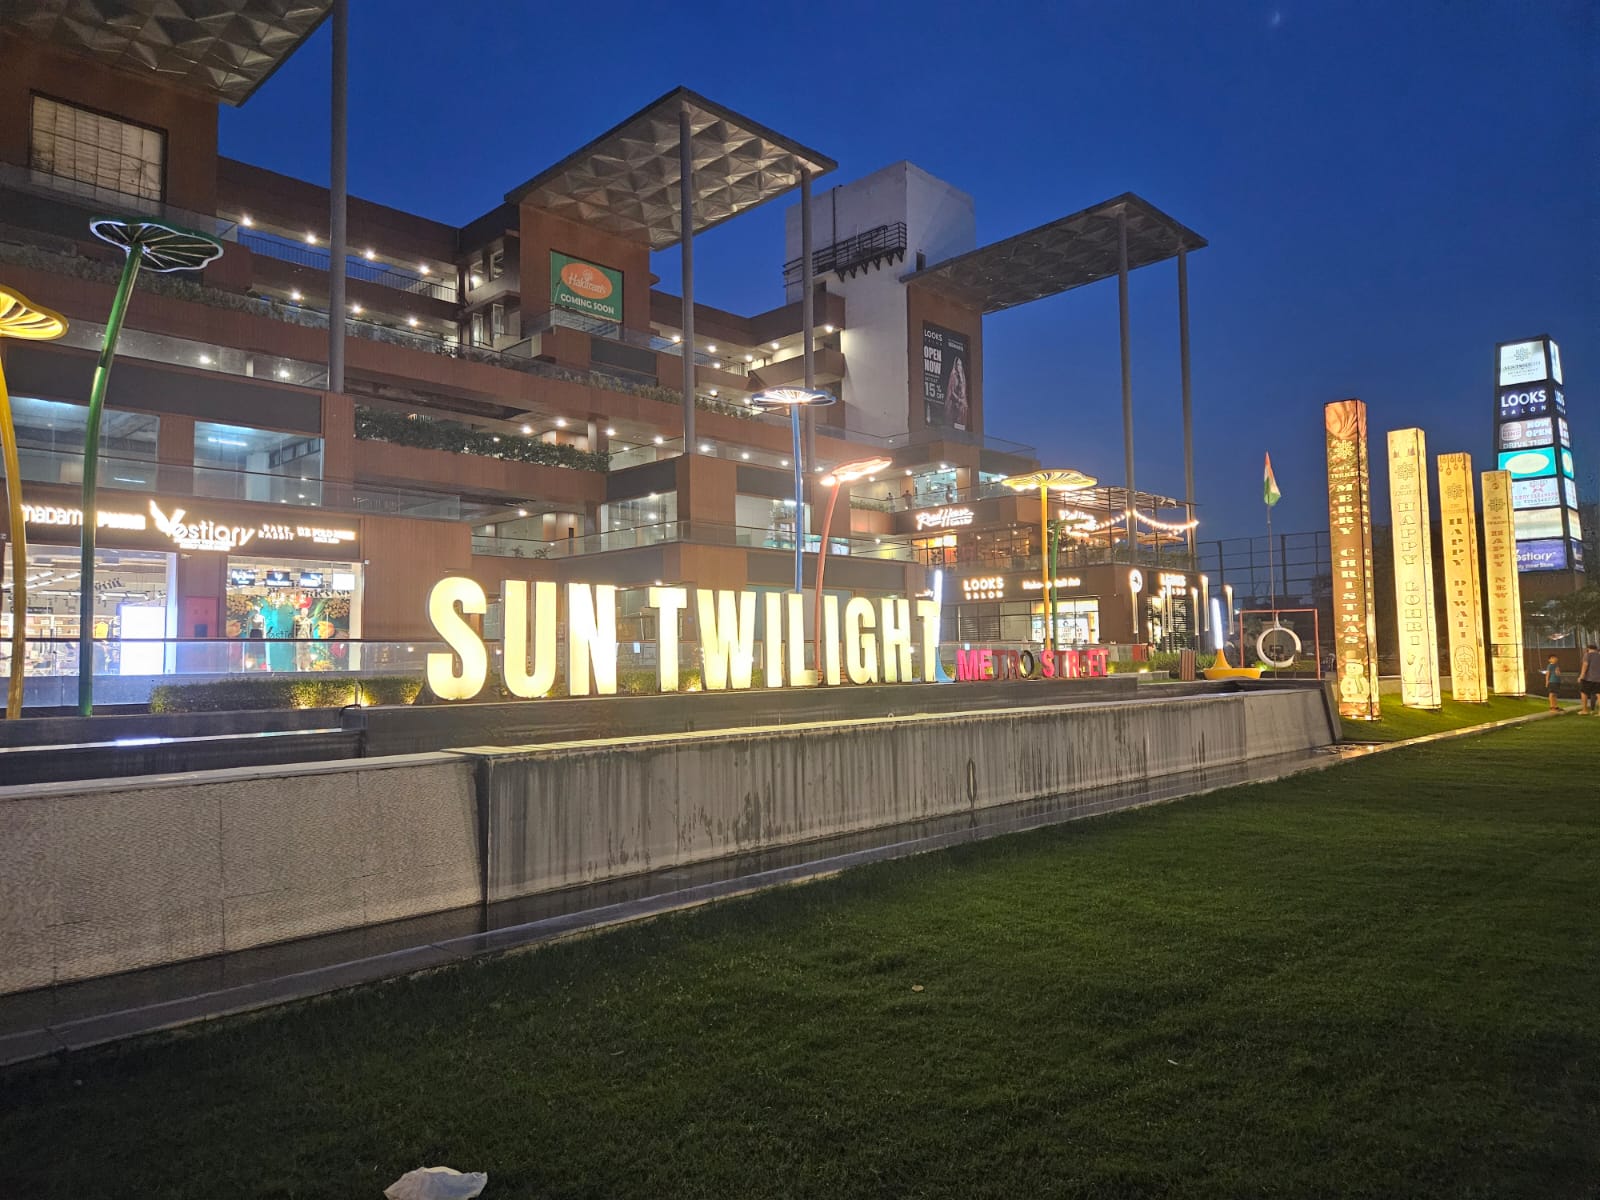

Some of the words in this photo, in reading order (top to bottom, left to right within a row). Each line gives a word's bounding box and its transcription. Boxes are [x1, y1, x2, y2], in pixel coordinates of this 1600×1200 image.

[560, 293, 593, 308] COMING
[593, 302, 615, 315] SOON
[924, 329, 943, 342] LOOKS
[923, 345, 942, 362] OPEN
[924, 359, 942, 374] NOW
[1501, 389, 1547, 408] LOOKS
[1502, 405, 1547, 416] SALON
[1336, 483, 1355, 535] MERRY
[1398, 502, 1418, 565] HAPPY
[1448, 517, 1464, 567] HAPPY
[1491, 529, 1505, 568] HAPPY
[963, 576, 1004, 591] LOOKS
[965, 590, 1004, 600] SALON
[1494, 576, 1508, 599] NEW
[1339, 548, 1359, 644] CHRISTMAS
[1497, 607, 1510, 638] YEAR
[427, 576, 618, 700] SUN
[648, 586, 940, 692] TWILIGHT
[956, 649, 1035, 682] METRO
[1041, 648, 1109, 680] STREET
